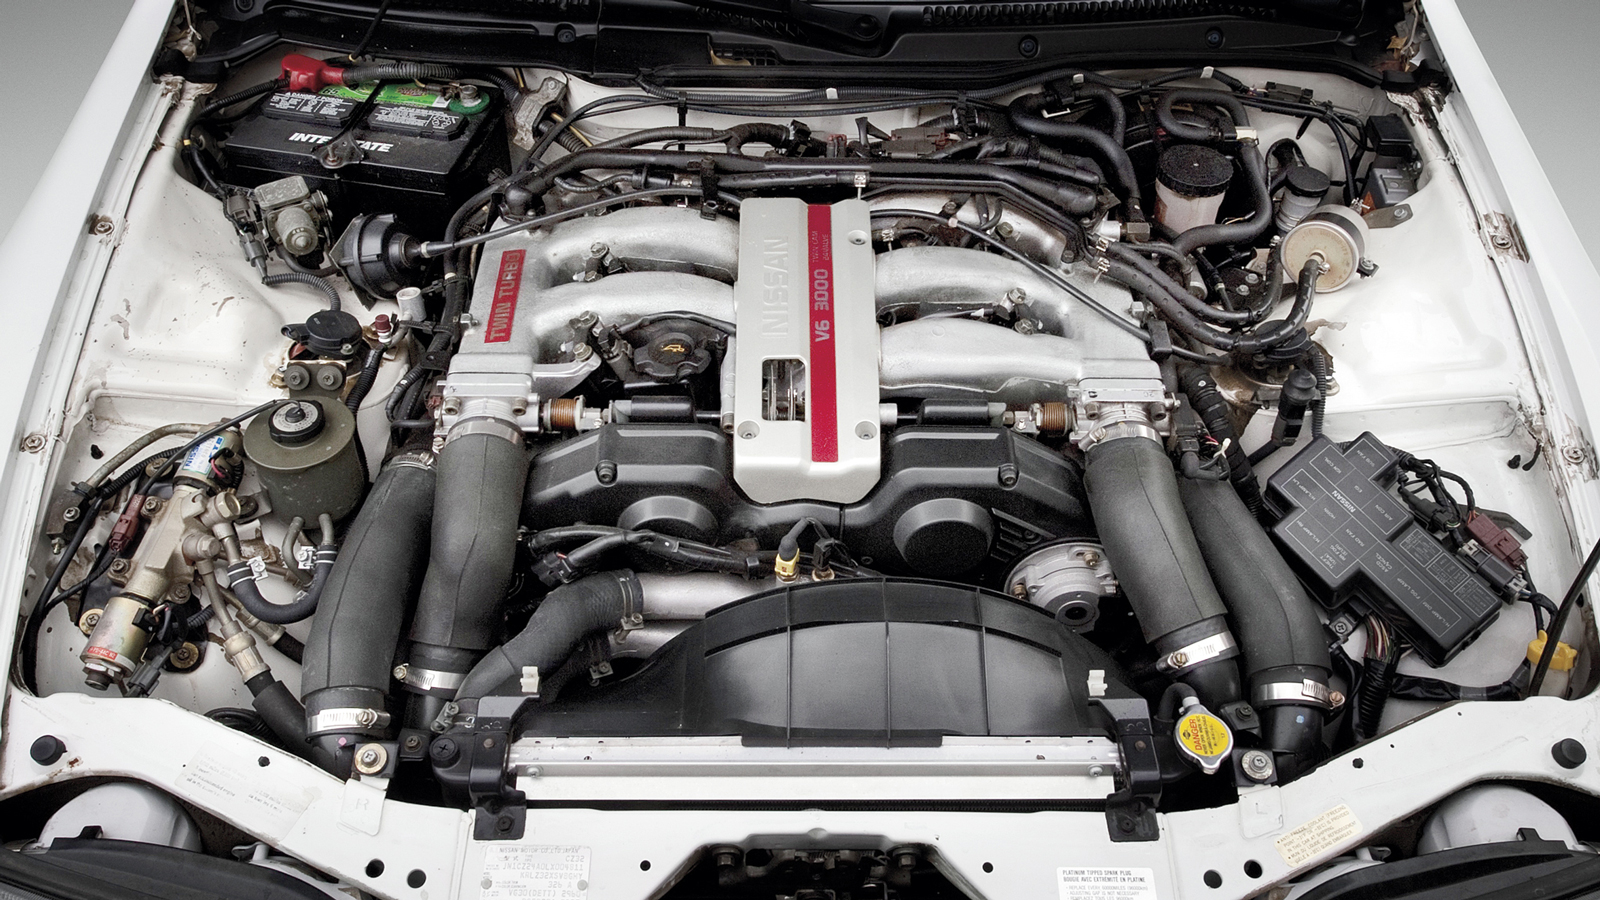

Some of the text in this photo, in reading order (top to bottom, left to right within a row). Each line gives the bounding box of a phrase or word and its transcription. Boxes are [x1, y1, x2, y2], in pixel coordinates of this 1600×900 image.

[288, 133, 394, 152] INTETATE
[490, 252, 520, 340] TWIN TURBO
[761, 236, 788, 338] NISSAN
[814, 268, 830, 342] V6 3000
[185, 442, 200, 467] NISS
[1323, 456, 1334, 466] COIL
[1356, 449, 1375, 467] SUB FAN
[1292, 477, 1299, 485] LH
[1331, 489, 1356, 512] NISSAN
[1323, 506, 1336, 519] HORN
[1374, 503, 1393, 521] AIR CON
[1295, 519, 1303, 527] RH
[1345, 527, 1365, 547] RAD FAN
[1329, 544, 1340, 554] FOG
[1319, 555, 1334, 569] THEFT
[1373, 551, 1393, 569] CANCEL
[1396, 576, 1421, 599] FOG LAMP
[1422, 600, 1432, 610] DIM
[1189, 719, 1202, 750] DANGER
